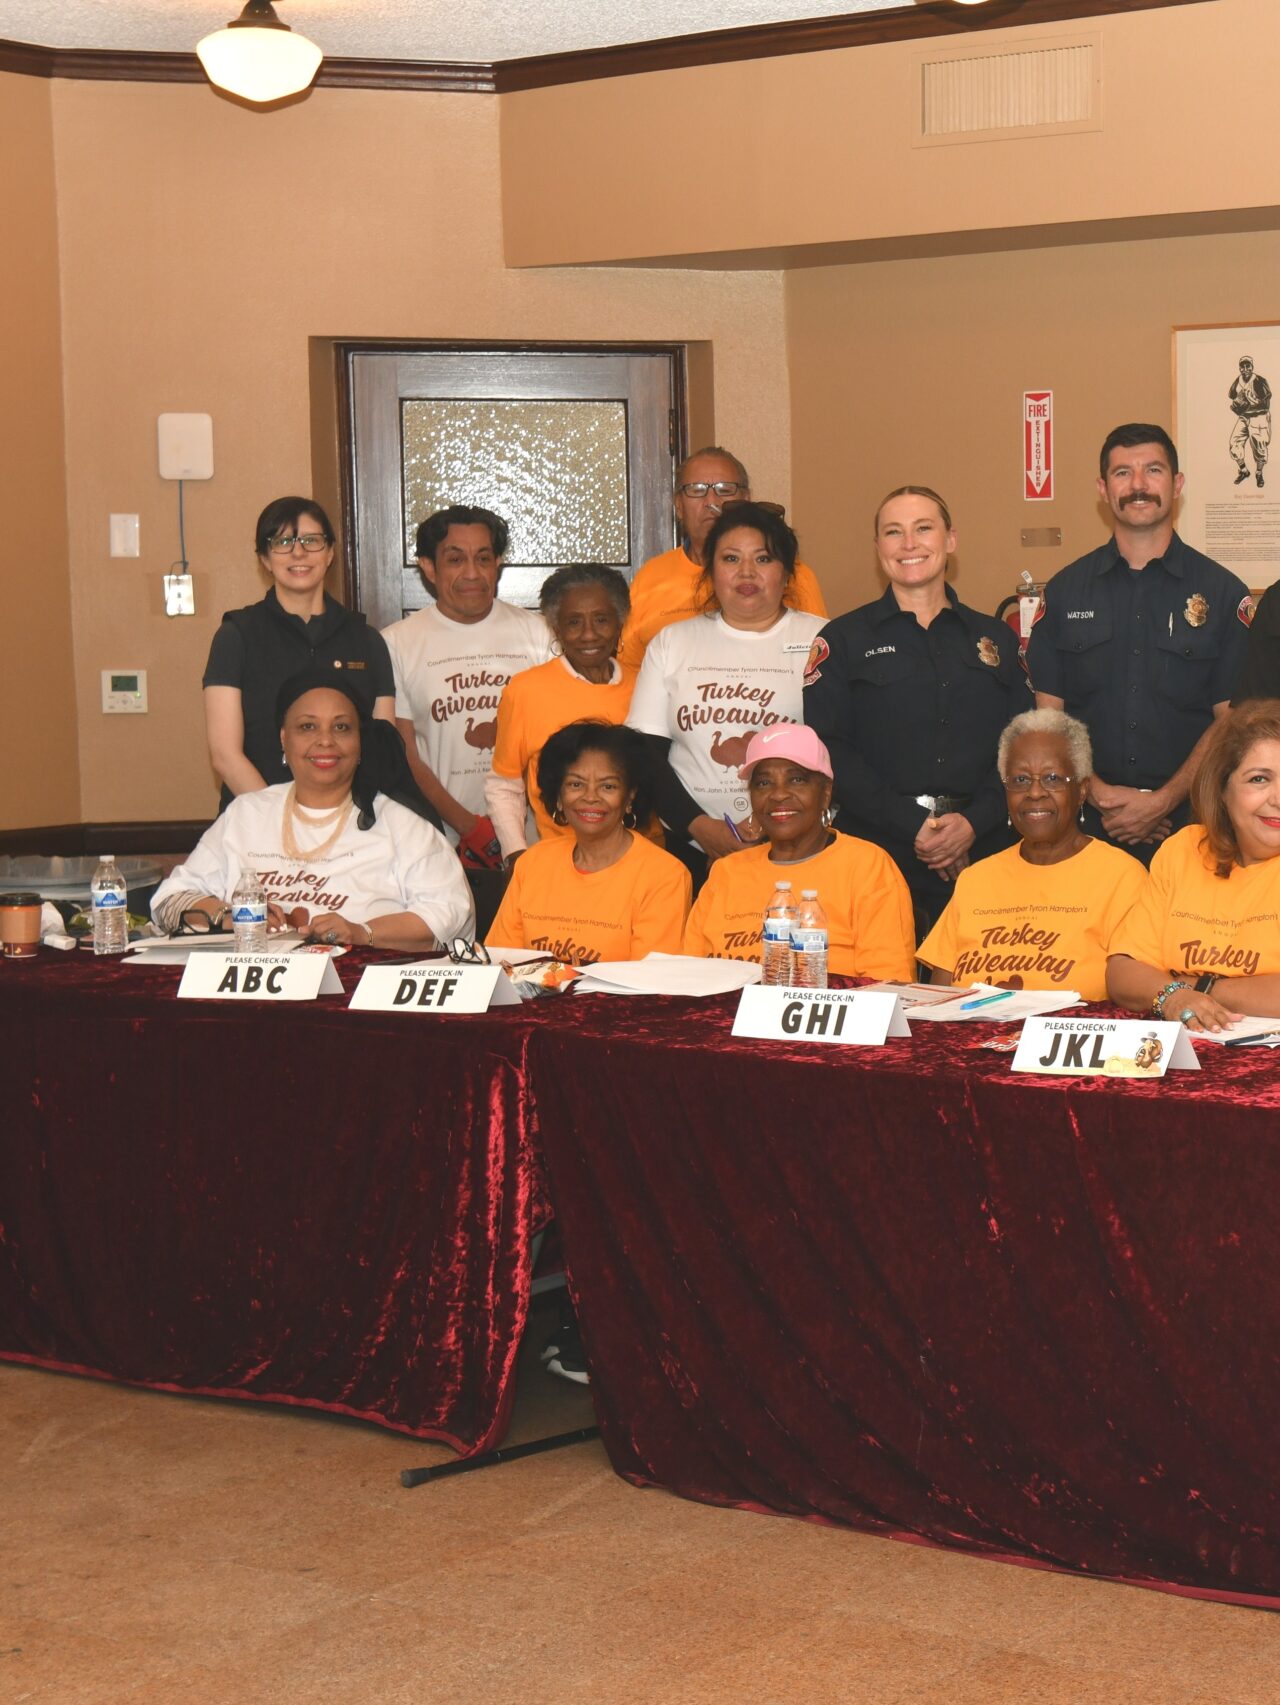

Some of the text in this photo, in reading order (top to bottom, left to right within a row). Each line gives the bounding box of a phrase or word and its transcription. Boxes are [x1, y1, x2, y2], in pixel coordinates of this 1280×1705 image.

[1028, 404, 1047, 418] FIRE
[1067, 610, 1095, 619] WATSON
[427, 654, 476, 668] Councilmember
[865, 646, 896, 658] OLSEN
[688, 666, 739, 674] Councilmember
[759, 667, 794, 675] Hampton's
[697, 682, 776, 708] Turkey
[431, 695, 503, 723] Givea
[677, 704, 798, 732] Giveawa
[257, 870, 331, 891] Turkey
[264, 887, 350, 911] eaway
[973, 904, 1088, 916] Councilmember Tyron Hampton's
[522, 912, 572, 924] Councilmember
[572, 916, 589, 926] Tyron
[589, 918, 623, 930] Hampton's
[981, 923, 1061, 951] Turkey
[225, 956, 290, 965] PLEASE CHECK-IN
[952, 950, 1076, 983] Giveaway
[1180, 940, 1261, 975] Turkey
[217, 966, 288, 993] ABC
[400, 969, 463, 978] PLEASE CHECK-IN
[393, 979, 458, 1007] DEF
[783, 991, 855, 1003] PLEASE CHECK-IN
[781, 1001, 848, 1036] GHI
[1044, 1022, 1116, 1032] PLEASE CHECK-IN
[1039, 1033, 1106, 1069] JKL
